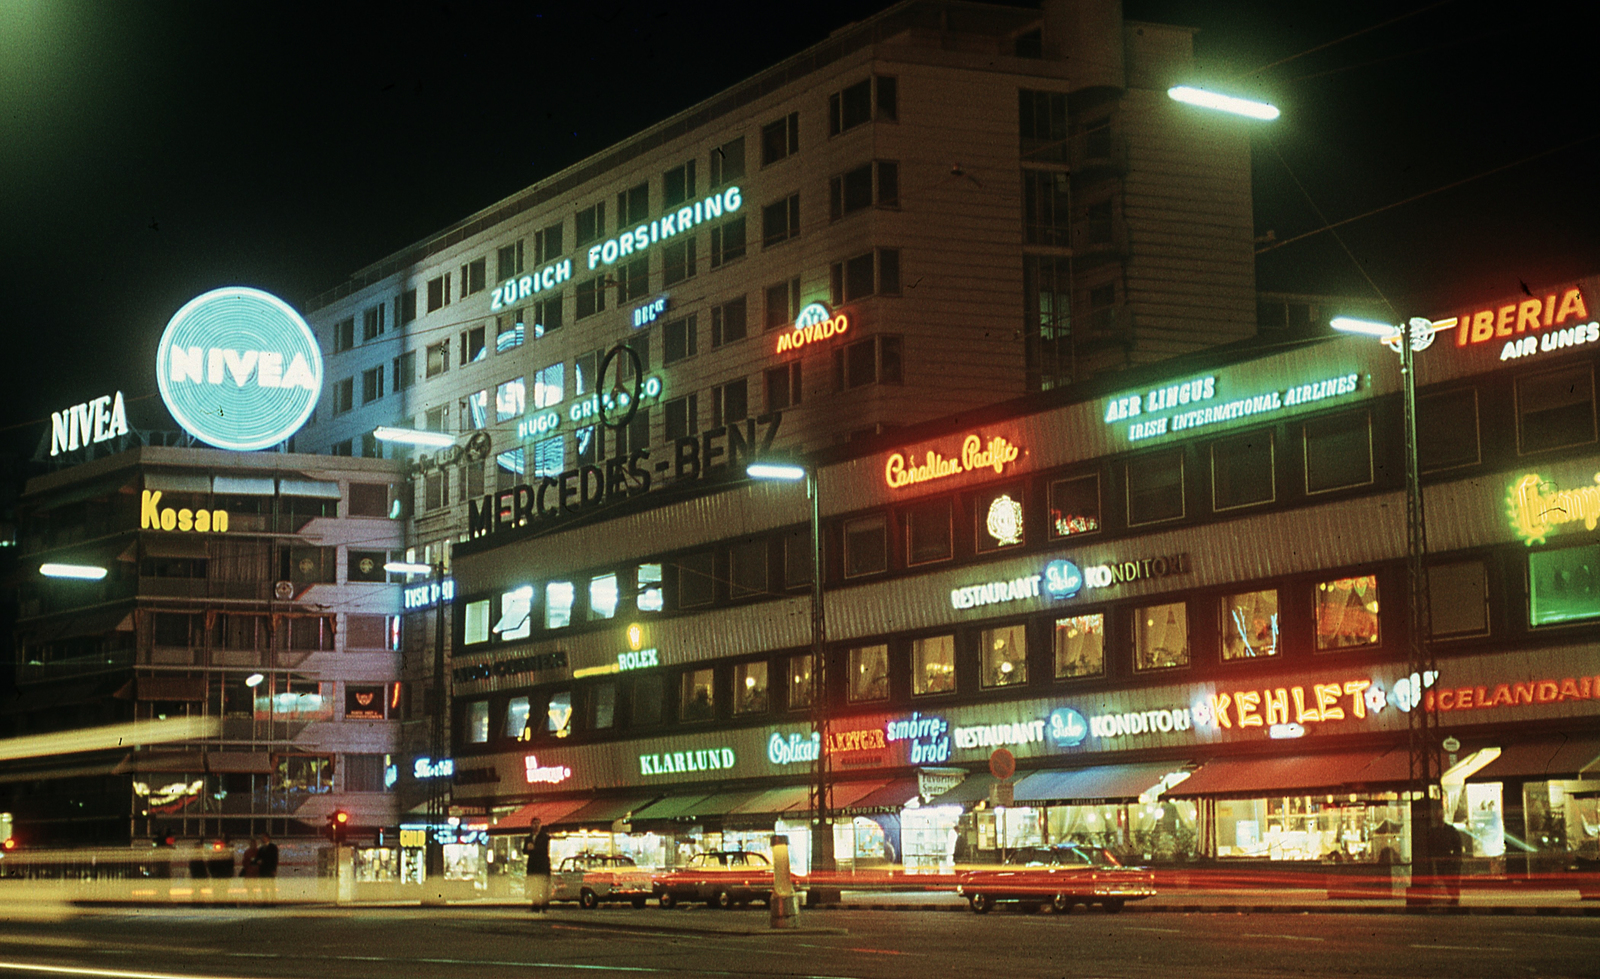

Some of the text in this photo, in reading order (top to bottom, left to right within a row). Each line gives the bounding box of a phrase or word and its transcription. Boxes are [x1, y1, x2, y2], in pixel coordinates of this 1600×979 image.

[490, 186, 742, 310] ZÜRICH FORSIKRING
[776, 314, 849, 354] MOVADO
[1458, 288, 1588, 346] IBERIA
[1500, 321, 1600, 361] AIR LINES
[171, 344, 317, 391] NIVEA
[50, 390, 128, 457] NIVEA
[1104, 376, 1215, 424] AER LINGUS
[1128, 374, 1358, 442] IRISH INTERNATIONAL AIRLINES
[518, 412, 559, 438] HUGO
[468, 411, 782, 536] MERCEDES-BENZ
[885, 434, 1018, 488] Canadian Pacific
[141, 489, 228, 532] Kosan
[951, 575, 1041, 609] RESTAURANT
[1084, 554, 1183, 588] KONDITORI
[618, 648, 659, 671] ROLEX
[954, 720, 1045, 748] RESTAURANT
[1090, 708, 1190, 738] KONDITORI
[1211, 679, 1371, 729] KEHLET
[639, 746, 736, 776] KLARLUND
